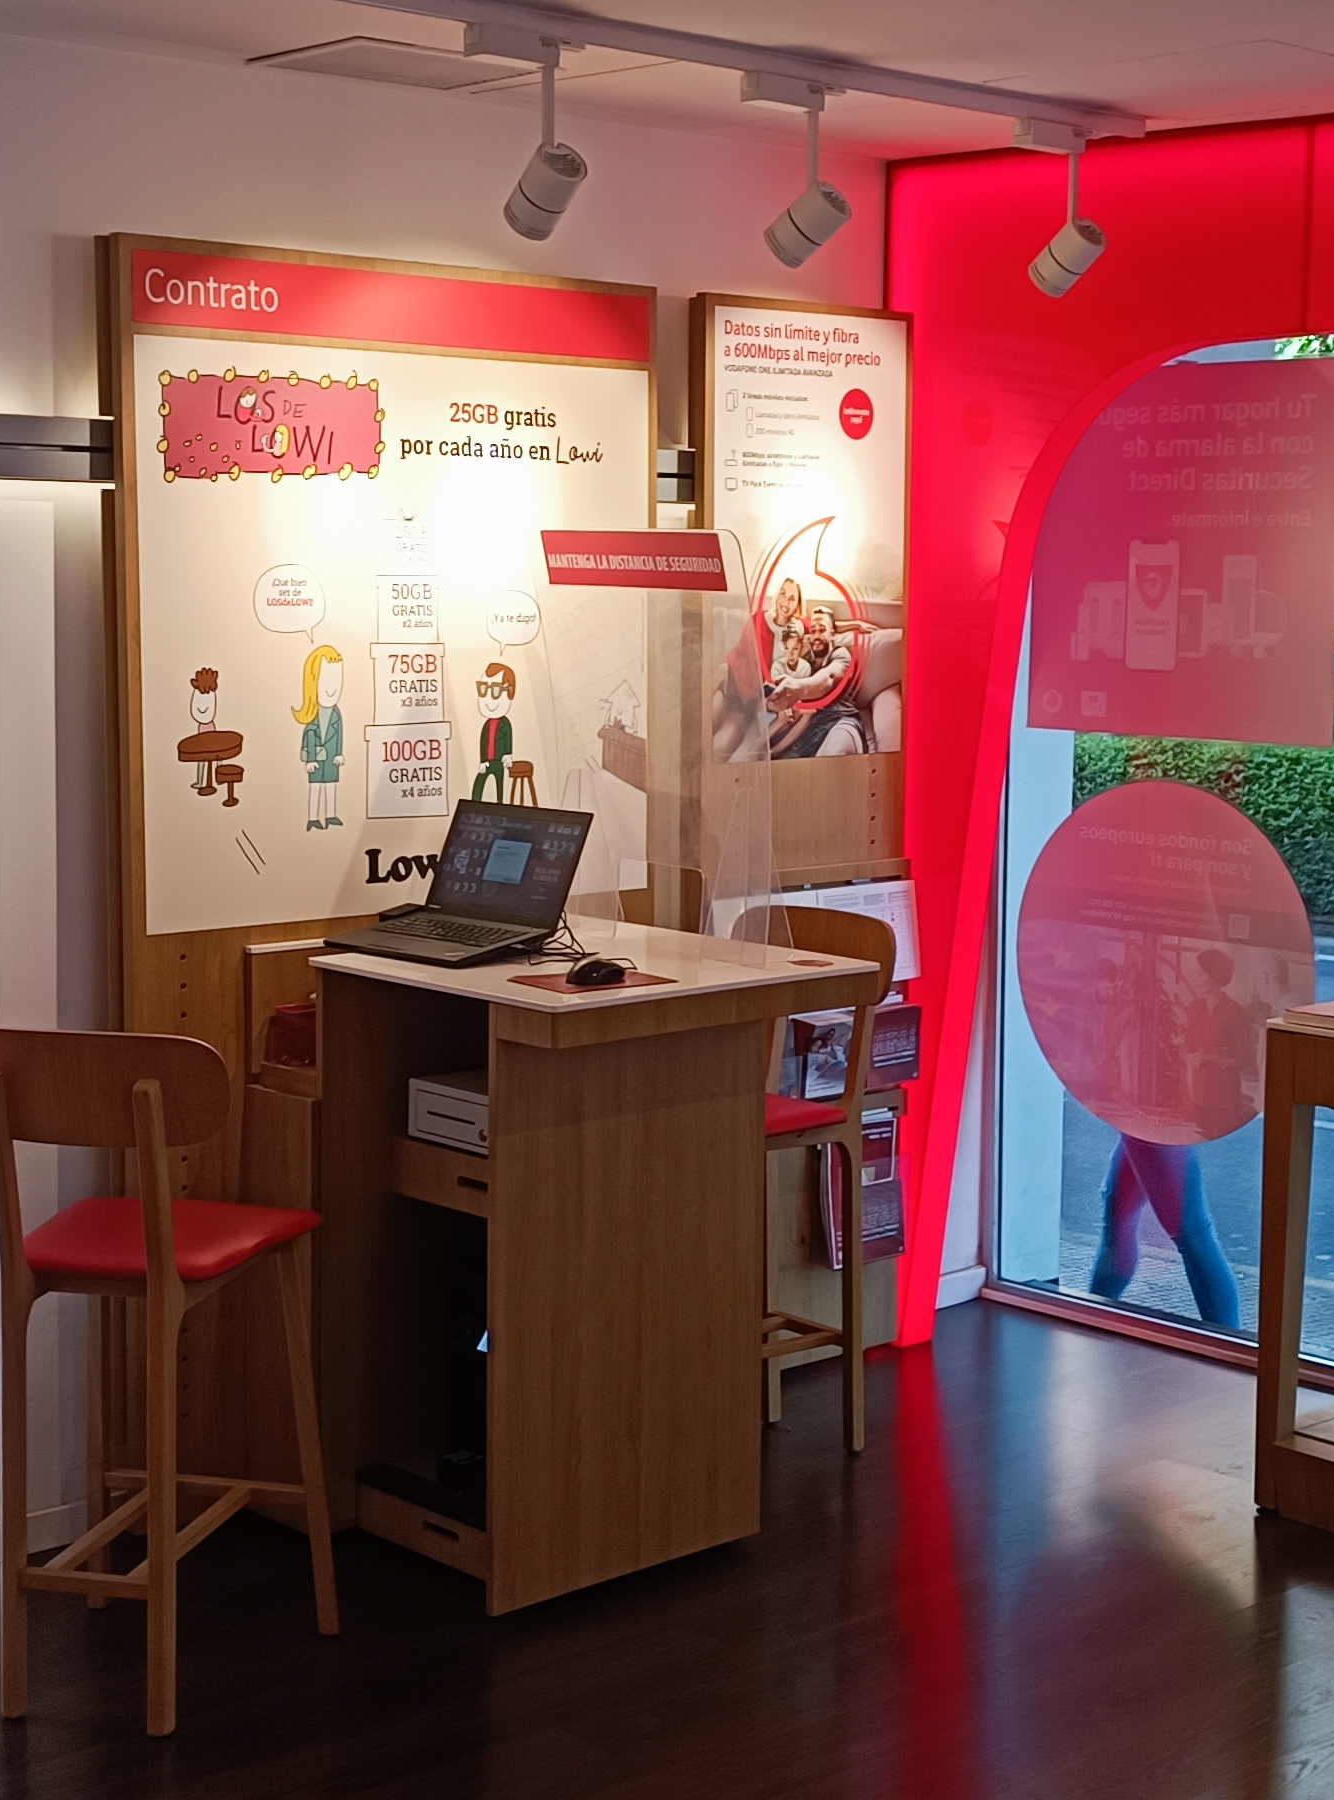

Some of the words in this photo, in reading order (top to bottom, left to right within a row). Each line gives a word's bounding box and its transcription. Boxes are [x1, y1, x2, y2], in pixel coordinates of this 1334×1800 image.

[144, 267, 279, 313] Contrato
[724, 320, 761, 338] Datos
[763, 323, 782, 339] sin
[784, 323, 821, 342] límite
[822, 330, 831, 346] y
[833, 328, 859, 344] fibra
[724, 345, 731, 357] a
[734, 343, 791, 364] 600Mbps
[793, 346, 804, 362] al
[807, 349, 843, 367] mejor
[845, 351, 881, 368] precio
[216, 385, 276, 425] LOS
[283, 399, 307, 418] DE
[449, 402, 499, 425] 25GB
[504, 406, 557, 430] gratis
[251, 423, 334, 465] LOWI
[400, 437, 434, 460] por
[438, 435, 484, 457] cada
[489, 438, 524, 459] año
[529, 444, 552, 461] en
[556, 435, 604, 464] Lowi
[548, 553, 596, 569] MANTENGA
[598, 555, 609, 570] LA
[610, 555, 655, 571] DISTANCIA
[656, 556, 668, 572] DE
[670, 557, 722, 573] SEGURIDAD
[292, 588, 302, 596] de
[392, 583, 433, 600] 50GB
[392, 604, 433, 616] GRATIS
[402, 619, 412, 628] x2
[414, 618, 433, 628] años
[388, 654, 438, 674] 75GB
[389, 679, 438, 693] GRATIS
[401, 696, 412, 707] x3
[415, 696, 438, 707] años
[382, 739, 442, 763] 100GB
[389, 766, 443, 783] GRATIS
[401, 786, 415, 798] x4
[417, 785, 443, 798] años
[365, 848, 440, 884] Low
